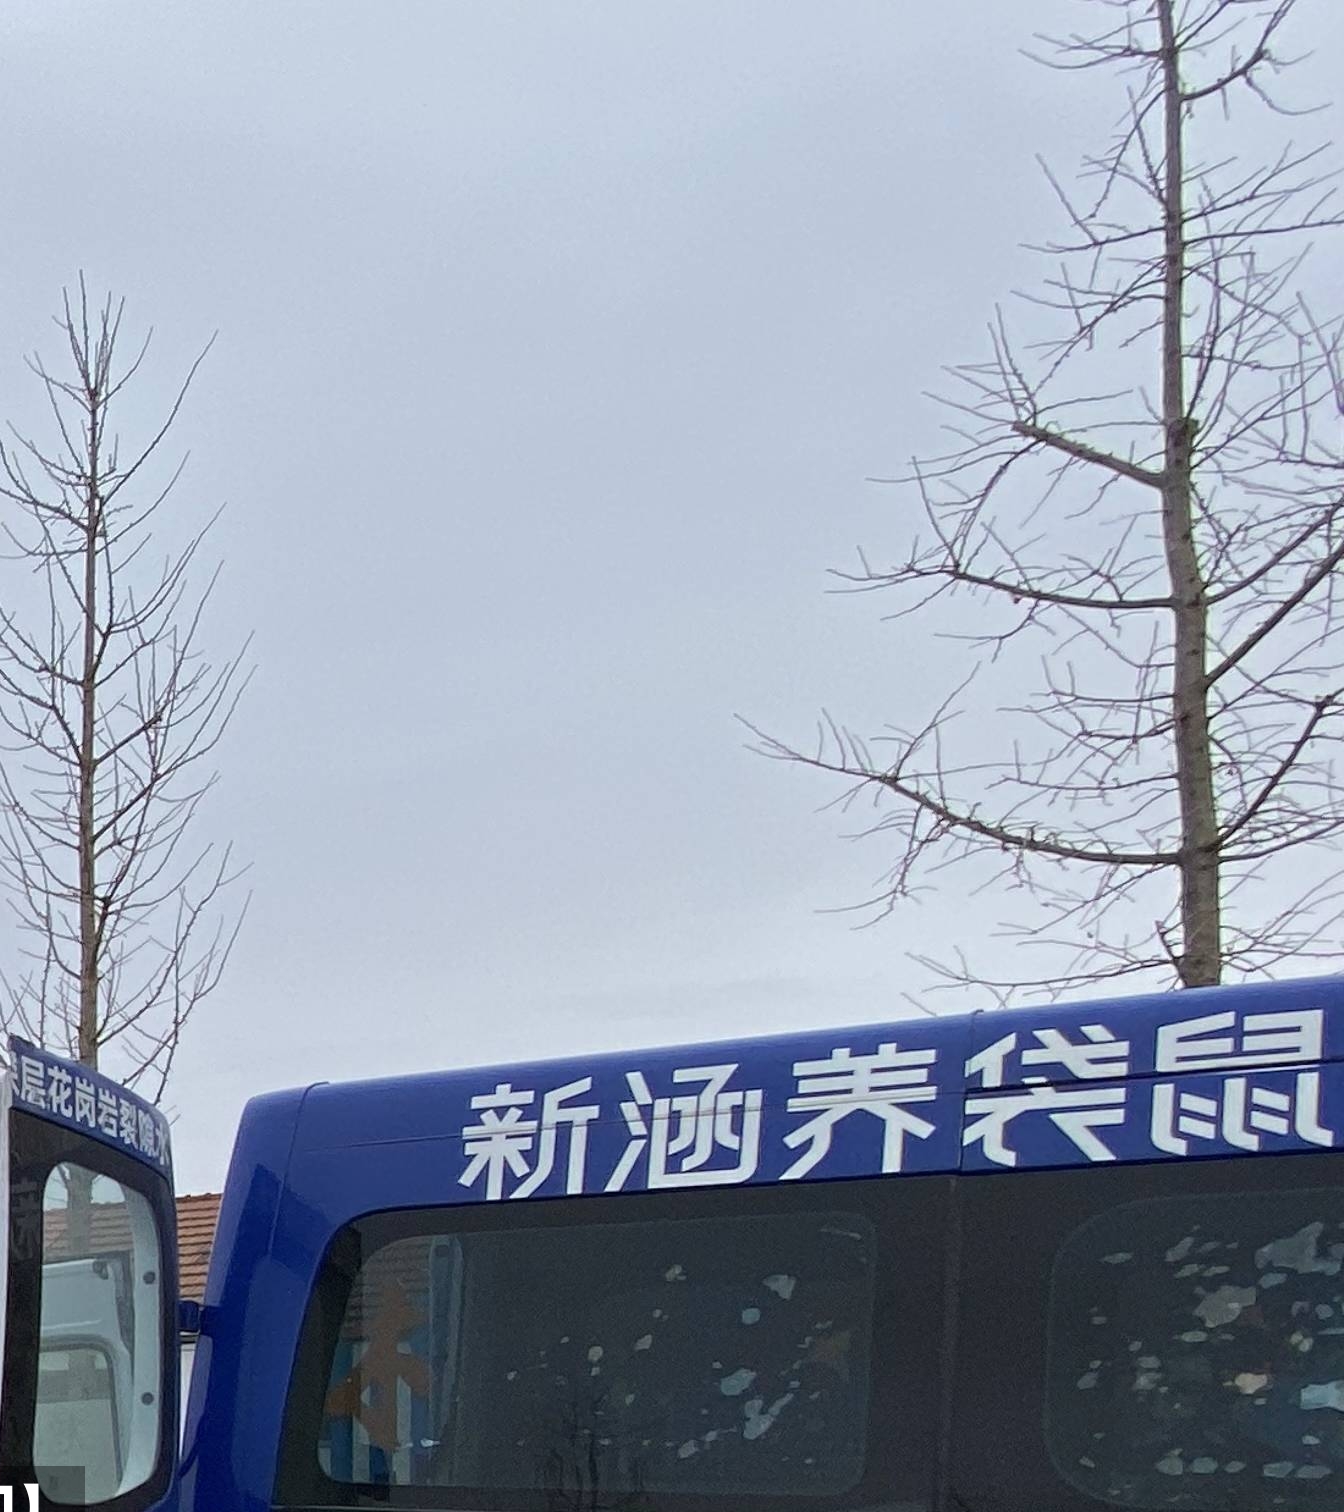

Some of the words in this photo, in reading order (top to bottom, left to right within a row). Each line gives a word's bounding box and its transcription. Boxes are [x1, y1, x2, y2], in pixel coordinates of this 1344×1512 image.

[458, 1009, 1334, 1201] 新涵养袋鼠
